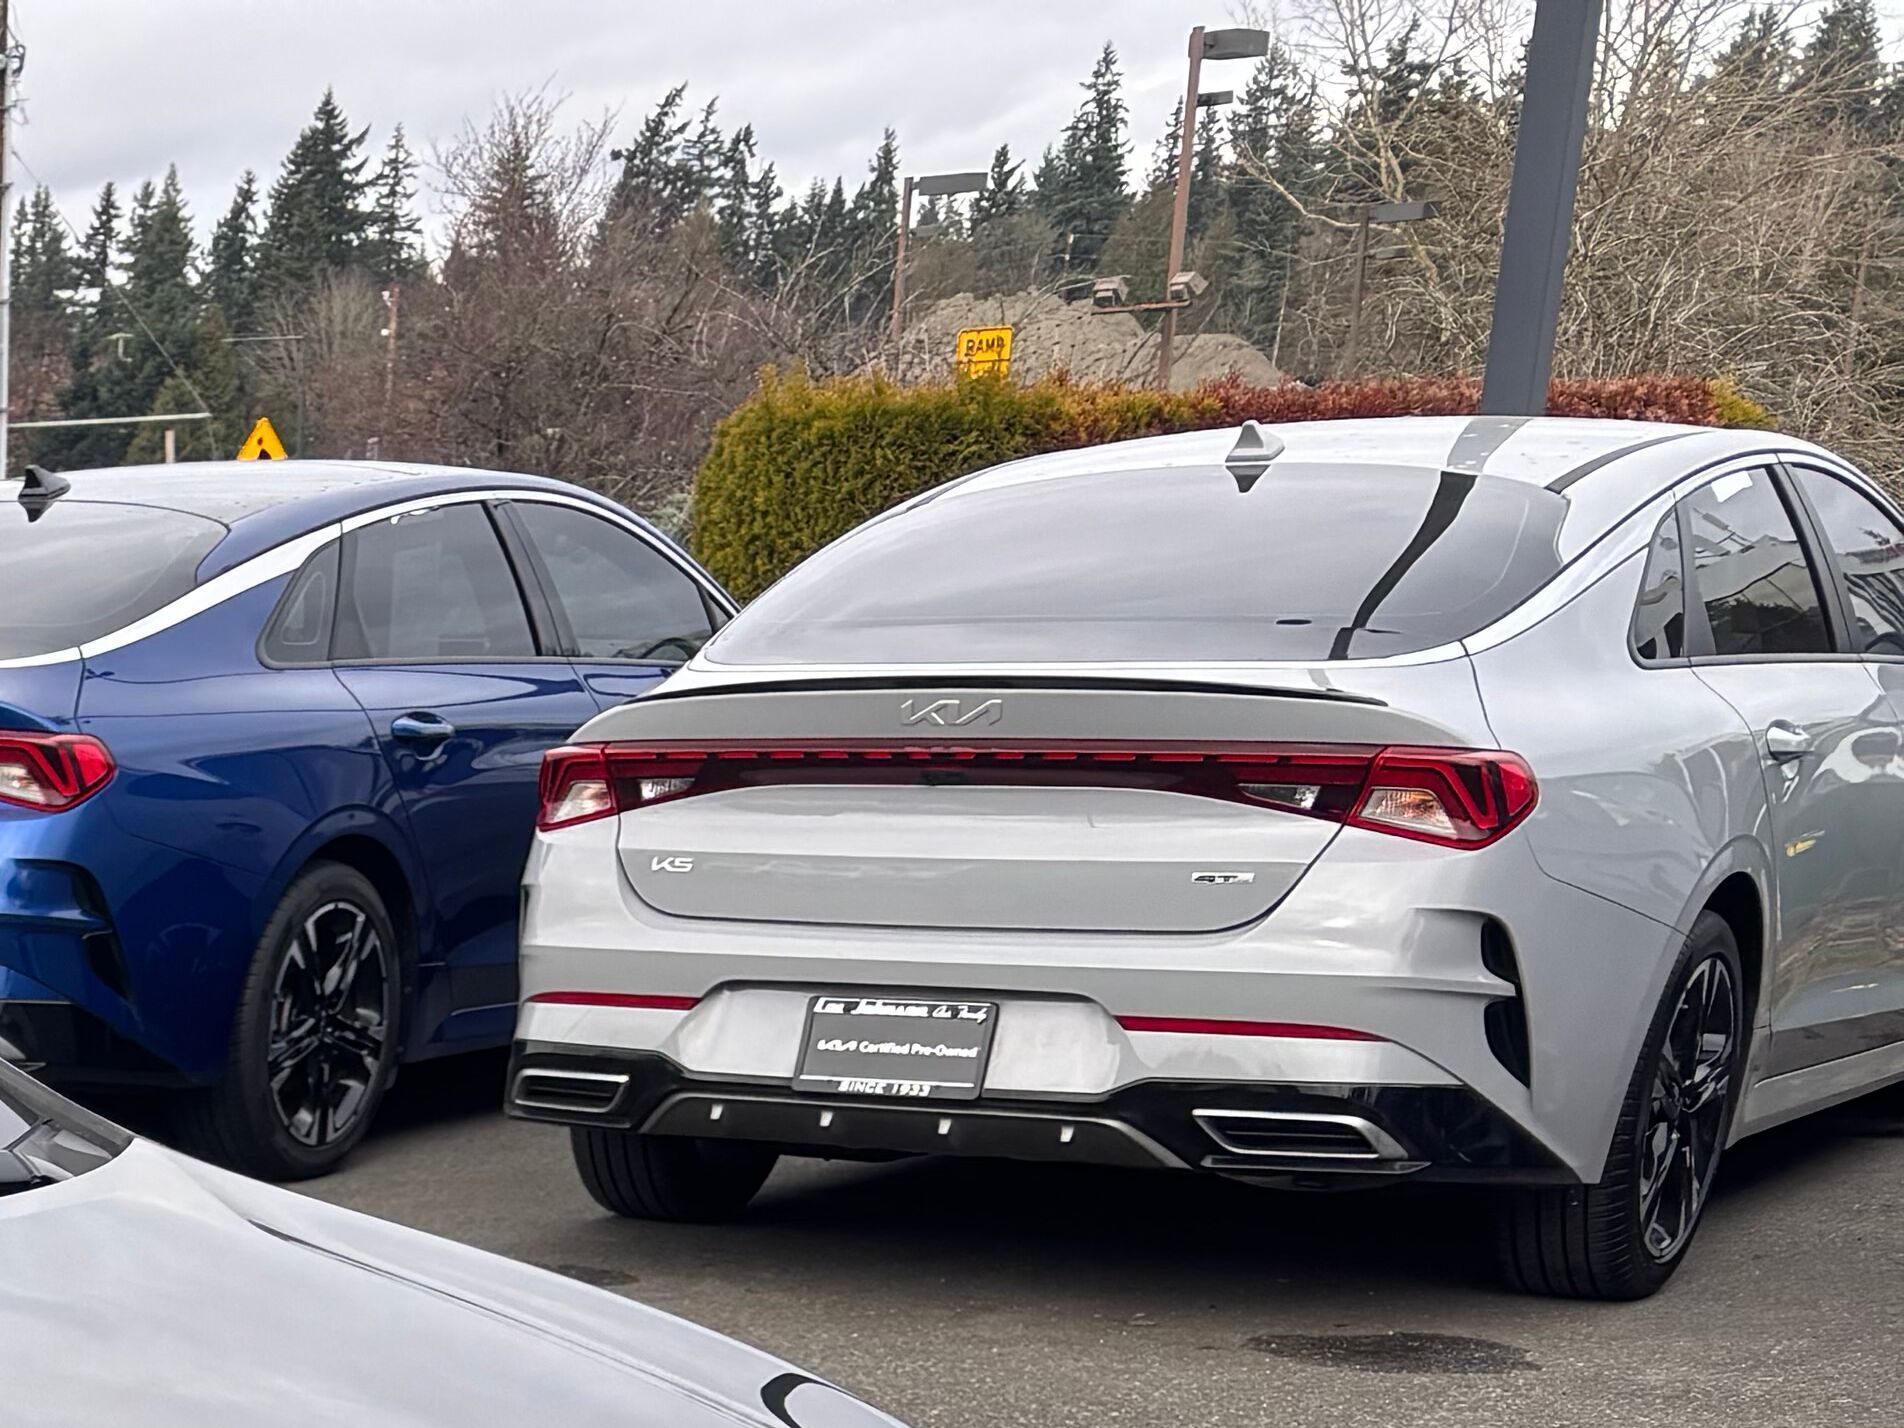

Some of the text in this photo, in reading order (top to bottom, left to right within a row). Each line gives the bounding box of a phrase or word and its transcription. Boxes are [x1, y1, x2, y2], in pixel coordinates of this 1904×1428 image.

[900, 698, 1003, 727] KIA
[650, 855, 695, 873] K5
[859, 1040, 910, 1056] Certified
[911, 1043, 979, 1058] Pre-Owned
[837, 1080, 932, 1098] SINCE 1933
